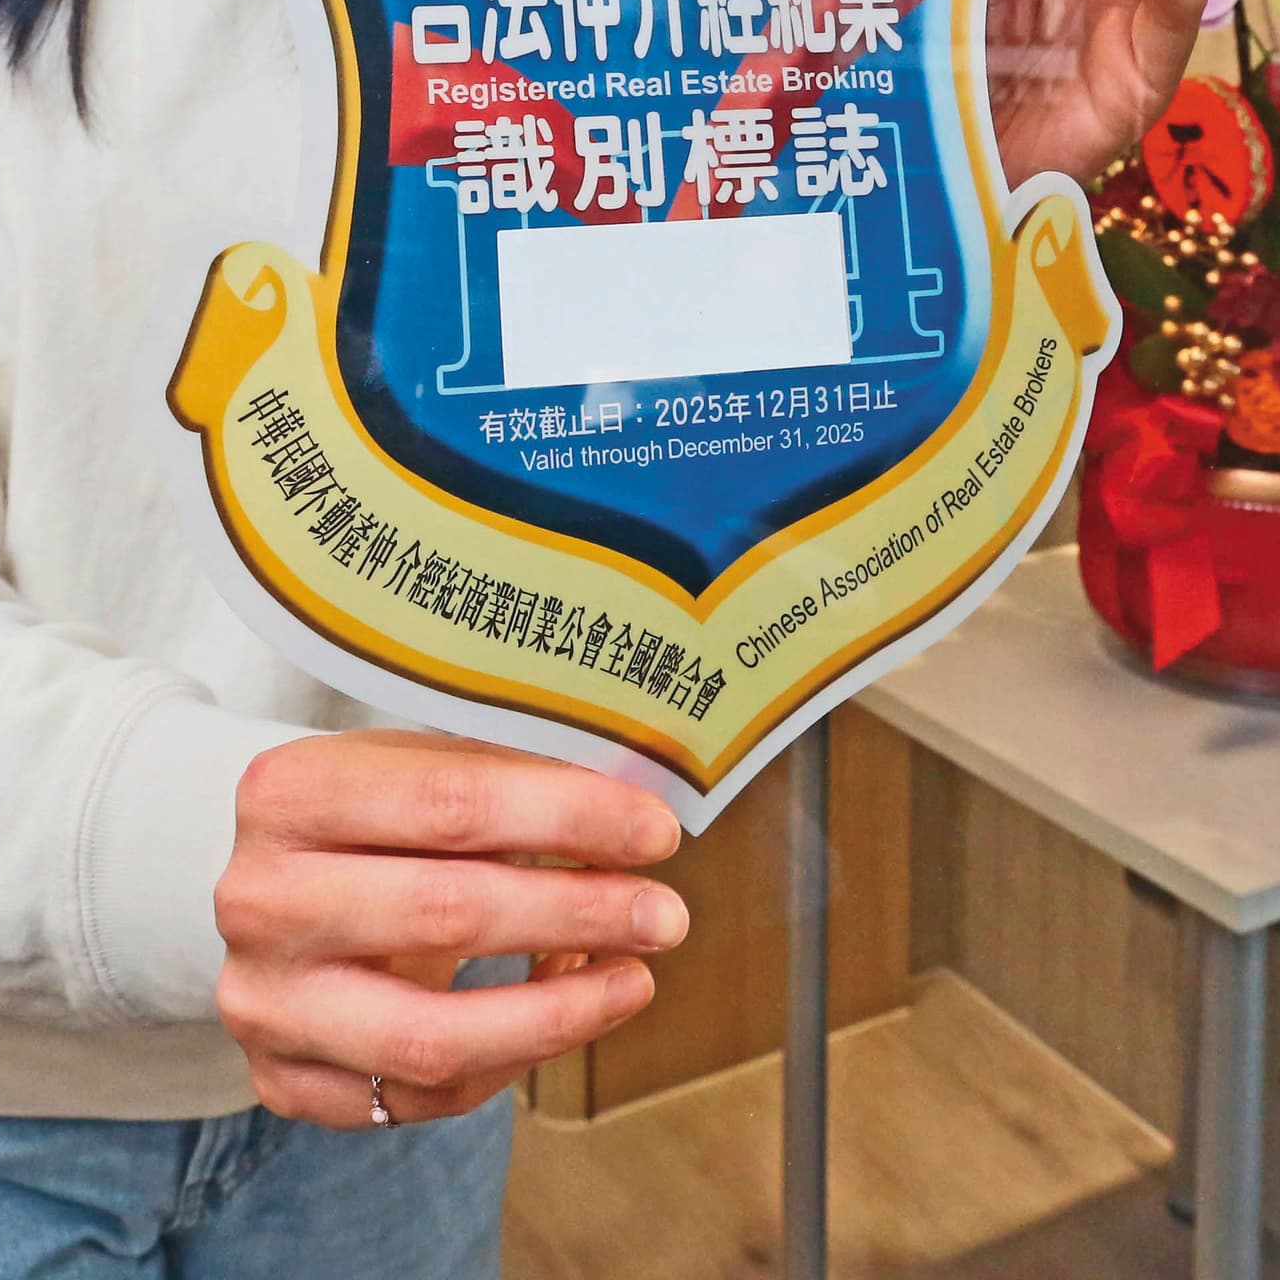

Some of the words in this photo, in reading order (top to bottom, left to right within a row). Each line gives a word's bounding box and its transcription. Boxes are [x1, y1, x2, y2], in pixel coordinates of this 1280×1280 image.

[427, 73, 597, 110] Registered
[606, 70, 672, 98] Real
[681, 68, 774, 96] Estate
[782, 65, 895, 96] Broking
[453, 103, 888, 214] 識別標誌
[520, 448, 574, 473] Valid
[581, 440, 663, 467] through
[668, 433, 775, 460] December
[779, 429, 810, 451] 31,
[816, 422, 864, 446] 2025
[735, 595, 819, 669] Chinese
[819, 524, 925, 608] Association
[925, 502, 945, 534] of
[941, 468, 984, 519] Real
[975, 415, 1025, 478] Estate
[1014, 336, 1057, 417] Brokers
[237, 388, 727, 722] 中華民國不動產仲介經紀商業同業公會全國聯合會
